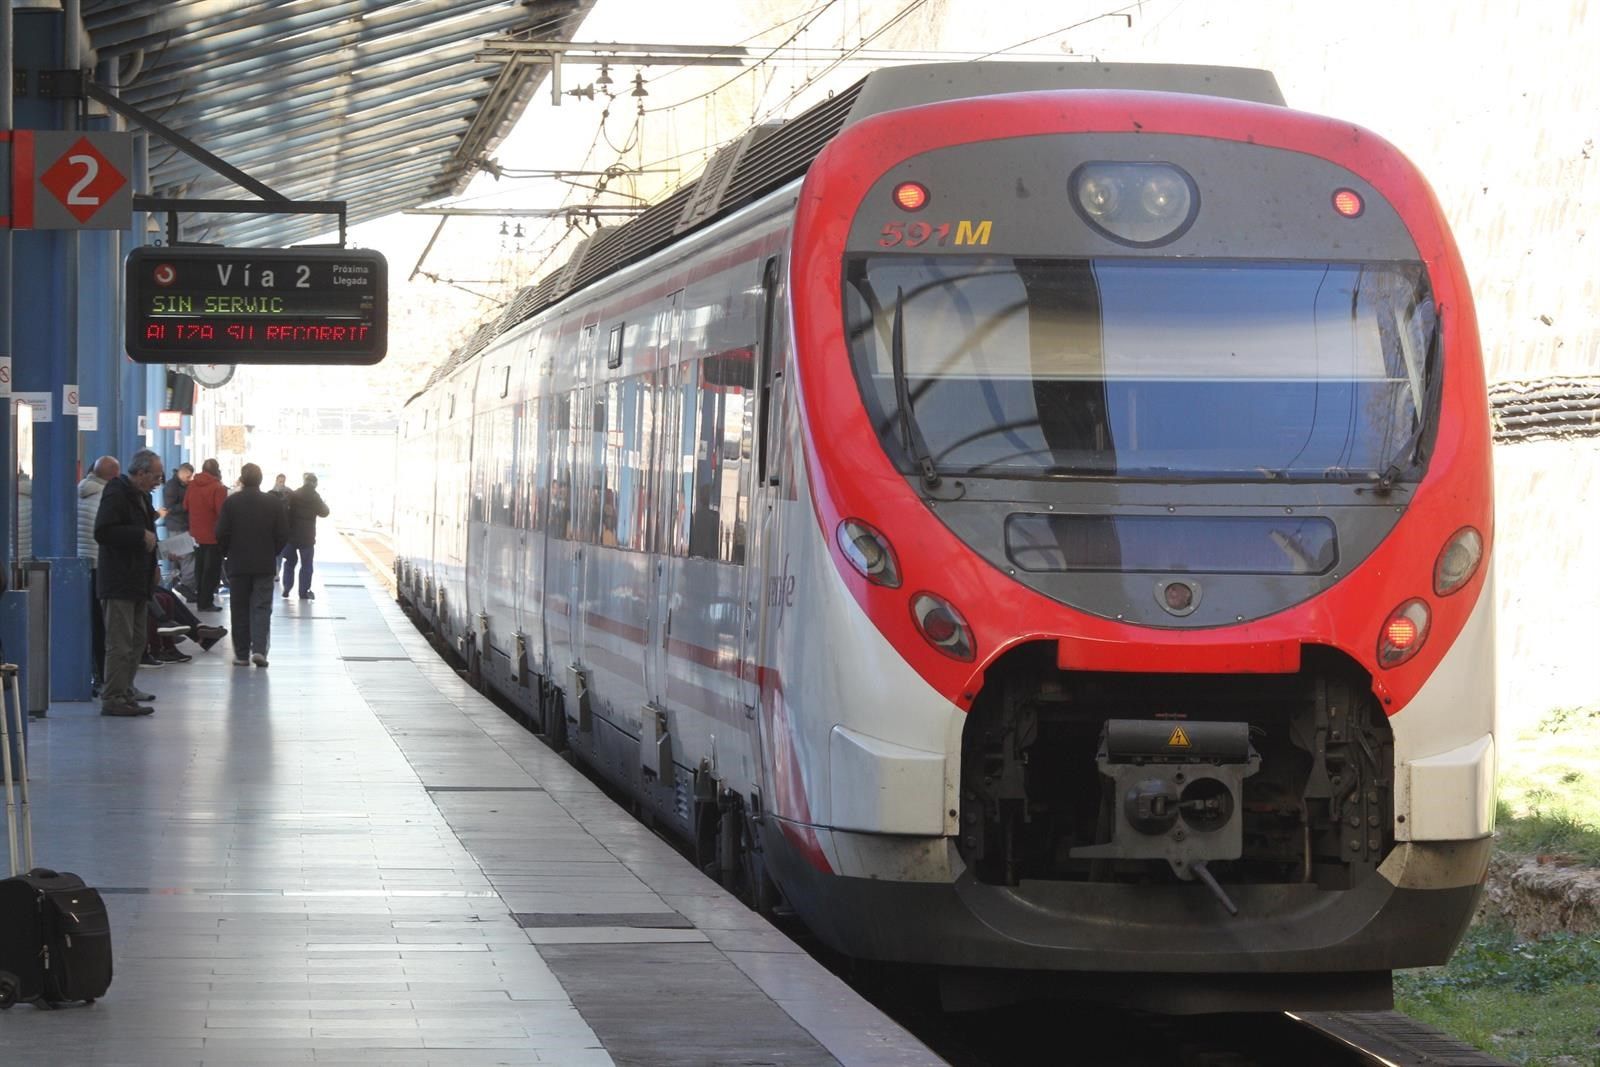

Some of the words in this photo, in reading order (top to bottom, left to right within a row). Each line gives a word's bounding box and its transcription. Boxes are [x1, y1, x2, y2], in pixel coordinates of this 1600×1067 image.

[67, 154, 99, 205] 2
[879, 220, 993, 248] 591M
[217, 263, 275, 287] Vía
[296, 265, 311, 288] 2
[332, 264, 369, 273] Próxima
[333, 276, 368, 287] Llegada
[152, 296, 192, 312] SIN
